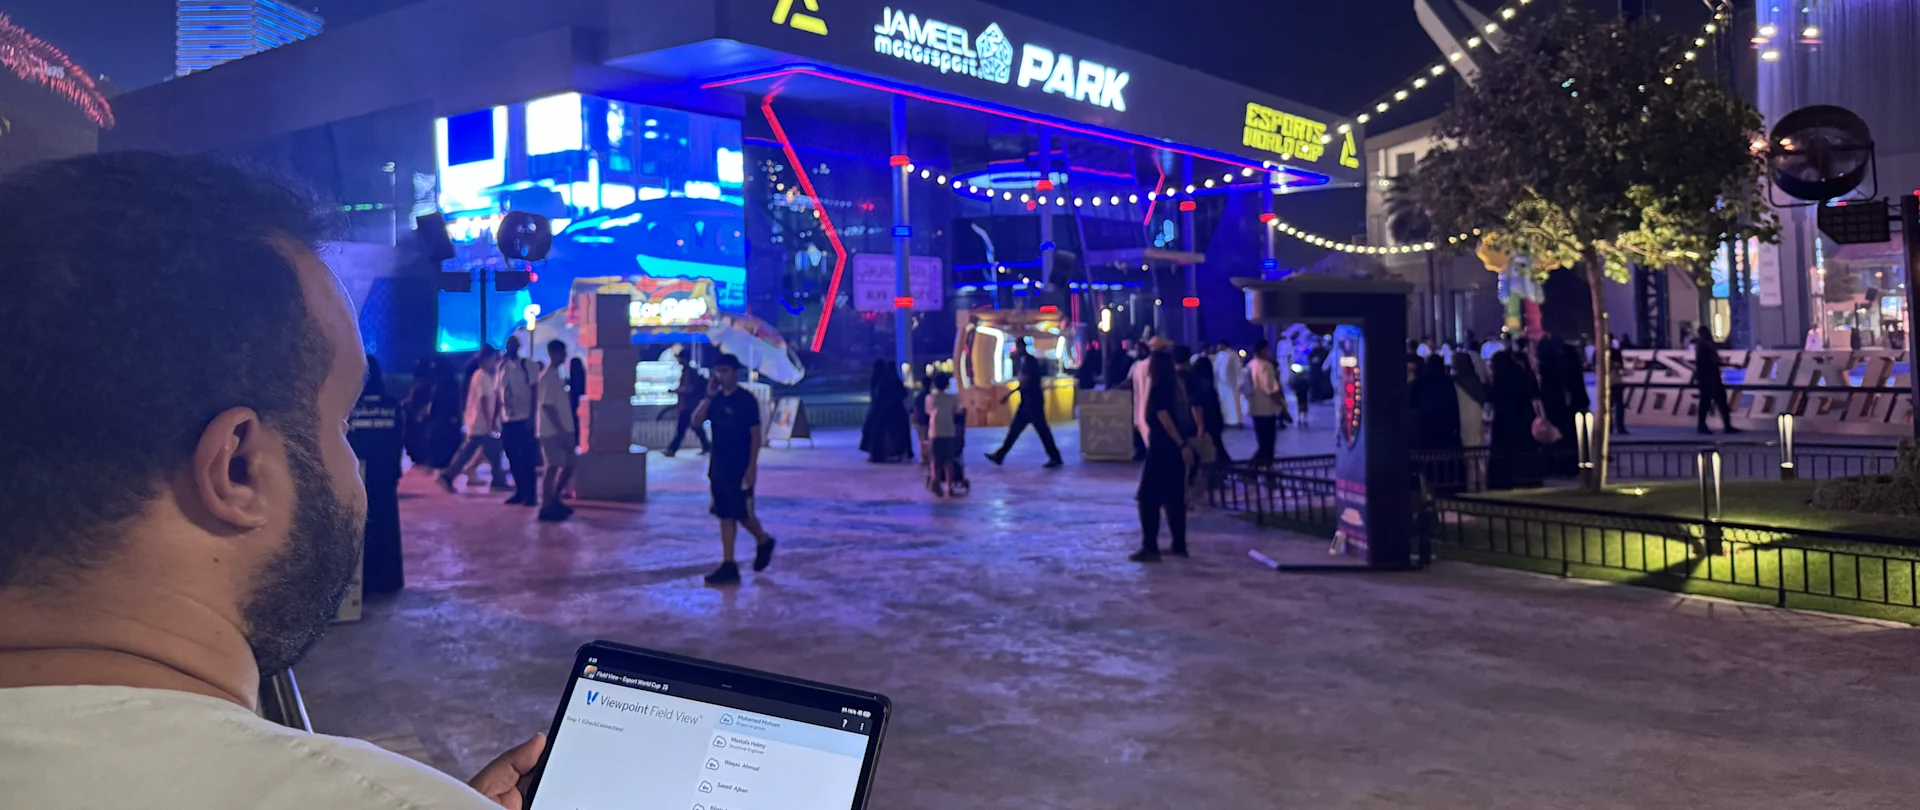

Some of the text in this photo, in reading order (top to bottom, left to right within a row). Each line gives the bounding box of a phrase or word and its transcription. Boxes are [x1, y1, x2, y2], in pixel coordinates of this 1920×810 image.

[874, 6, 978, 59] JAMEEL
[1017, 43, 1130, 112] PARK
[1245, 102, 1327, 145] ESPORTS
[1242, 126, 1325, 162] WORLD CUP
[596, 671, 609, 679] Field
[637, 678, 652, 687] World
[651, 681, 662, 690] Cup
[600, 695, 649, 715] Viewpoint
[649, 705, 674, 720] Field
[730, 736, 750, 746] Mostafa
[724, 759, 760, 772] Waqas Ahmad
[717, 782, 732, 790] Saeed
